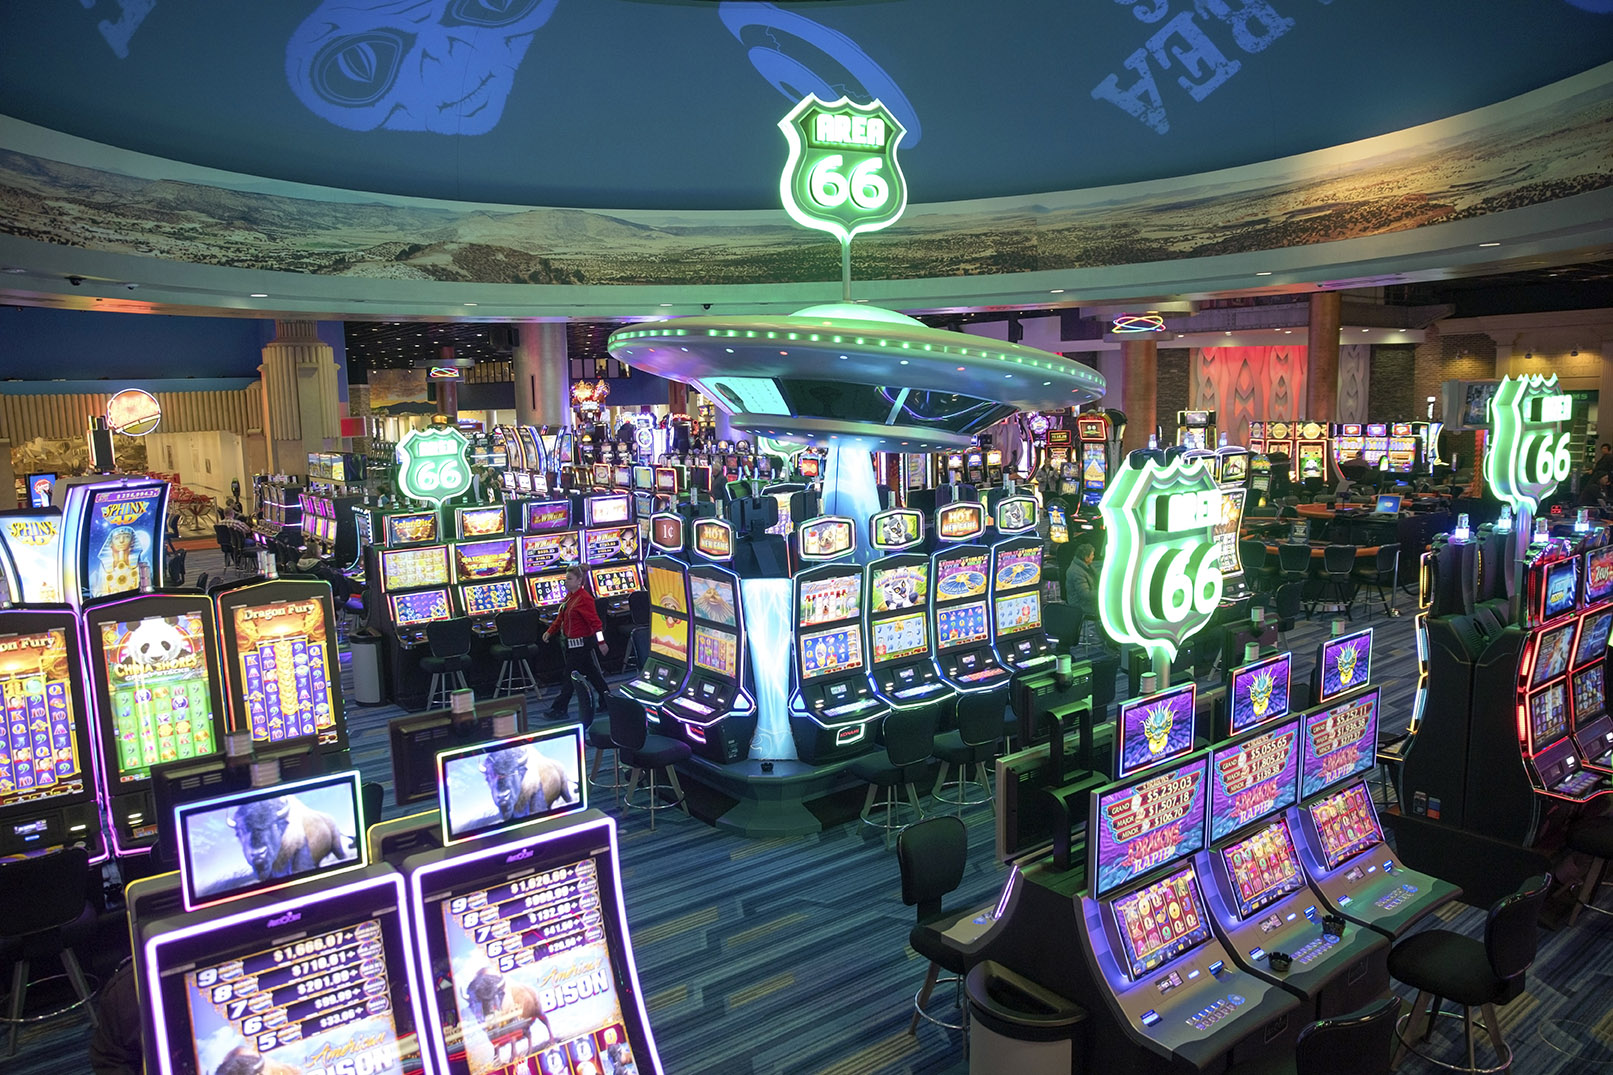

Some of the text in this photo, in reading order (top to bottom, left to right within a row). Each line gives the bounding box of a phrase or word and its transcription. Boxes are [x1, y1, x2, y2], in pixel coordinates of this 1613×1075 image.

[817, 114, 885, 146] AREA
[809, 154, 889, 209] 66
[1536, 432, 1571, 485] 66
[416, 460, 462, 490] 66
[103, 501, 147, 518] SPHINX
[110, 514, 138, 525] 4D
[948, 509, 973, 523] HOT
[10, 521, 57, 538] SPHINX
[663, 525, 674, 539] 1¢
[703, 525, 725, 539] HOT
[1162, 543, 1223, 622] 66
[244, 604, 315, 620] Dragon Fury
[20, 637, 55, 649] Fury
[294, 643, 303, 653] 9
[262, 647, 274, 658] A
[309, 646, 321, 656] Q
[114, 653, 197, 677] CHINA SHORES
[246, 655, 258, 666] K
[263, 659, 276, 669] 10
[248, 667, 260, 678] A
[313, 669, 322, 679] 9
[250, 679, 259, 689] J
[266, 683, 278, 693] Q
[298, 677, 307, 687] J
[313, 681, 325, 691] 10
[49, 685, 63, 695] Q
[299, 689, 310, 700] A
[30, 695, 42, 705] 9
[268, 694, 277, 704] J
[316, 692, 324, 702] J
[31, 707, 46, 719] 10
[252, 702, 264, 714] A
[270, 706, 279, 716] 9
[11, 710, 25, 722] K
[52, 710, 66, 722] 10
[254, 715, 266, 725] 10
[287, 715, 295, 725] J
[302, 712, 311, 722] 9
[12, 723, 27, 735] Q
[54, 724, 68, 735] A
[287, 727, 299, 737] A
[303, 723, 315, 733] Q
[35, 733, 47, 744] 9
[272, 729, 283, 740] 10
[14, 736, 26, 748] J
[56, 736, 67, 748] J
[36, 746, 50, 757] Q
[18, 763, 30, 774] 9
[59, 763, 70, 773] 9
[19, 776, 33, 788] 10
[39, 772, 56, 784] A
[1147, 776, 1192, 803] $5,239.03
[1111, 803, 1130, 815] GRAND
[1149, 791, 1190, 815] $1,507.18
[1116, 815, 1134, 828] MAJOR
[1154, 807, 1183, 826] $106.70
[1121, 827, 1139, 839] MINOR
[1234, 854, 1242, 866] 9
[1259, 858, 1267, 871] 9
[452, 898, 466, 914] 9
[464, 912, 479, 928] 8
[477, 926, 491, 942] 7
[1162, 926, 1171, 940] 9
[488, 941, 503, 957] 6
[500, 955, 515, 971] 5
[198, 969, 217, 987] 9
[214, 985, 233, 1003] 8
[539, 967, 609, 1013] BISON
[230, 999, 248, 1019] 7
[244, 1016, 262, 1035] 6
[259, 1031, 277, 1052] 5
[304, 1031, 386, 1068] American
